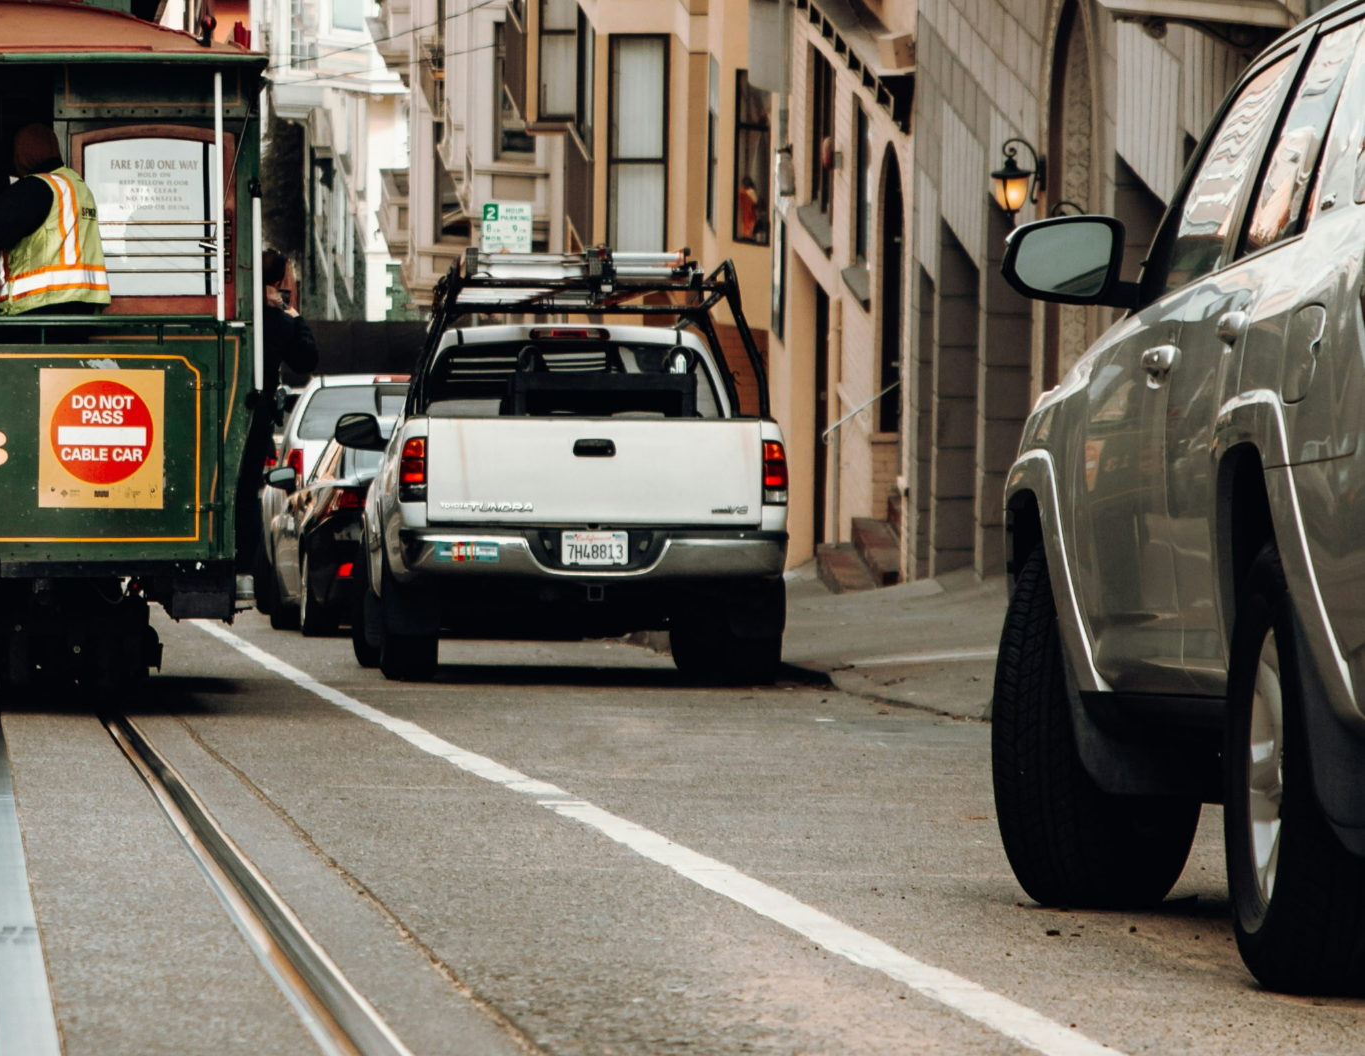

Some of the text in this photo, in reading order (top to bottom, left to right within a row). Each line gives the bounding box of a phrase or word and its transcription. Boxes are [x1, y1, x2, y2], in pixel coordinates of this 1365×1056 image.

[110, 159, 199, 170] FARE $7.00 ONE WAY
[486, 207, 496, 219] 2
[71, 394, 134, 410] DO NOT
[81, 410, 124, 425] PASS
[60, 447, 143, 462] CABLE CAR
[440, 501, 534, 512] TOYOTA TUNDRA
[575, 533, 612, 543] California
[567, 544, 624, 560] 7H48813
